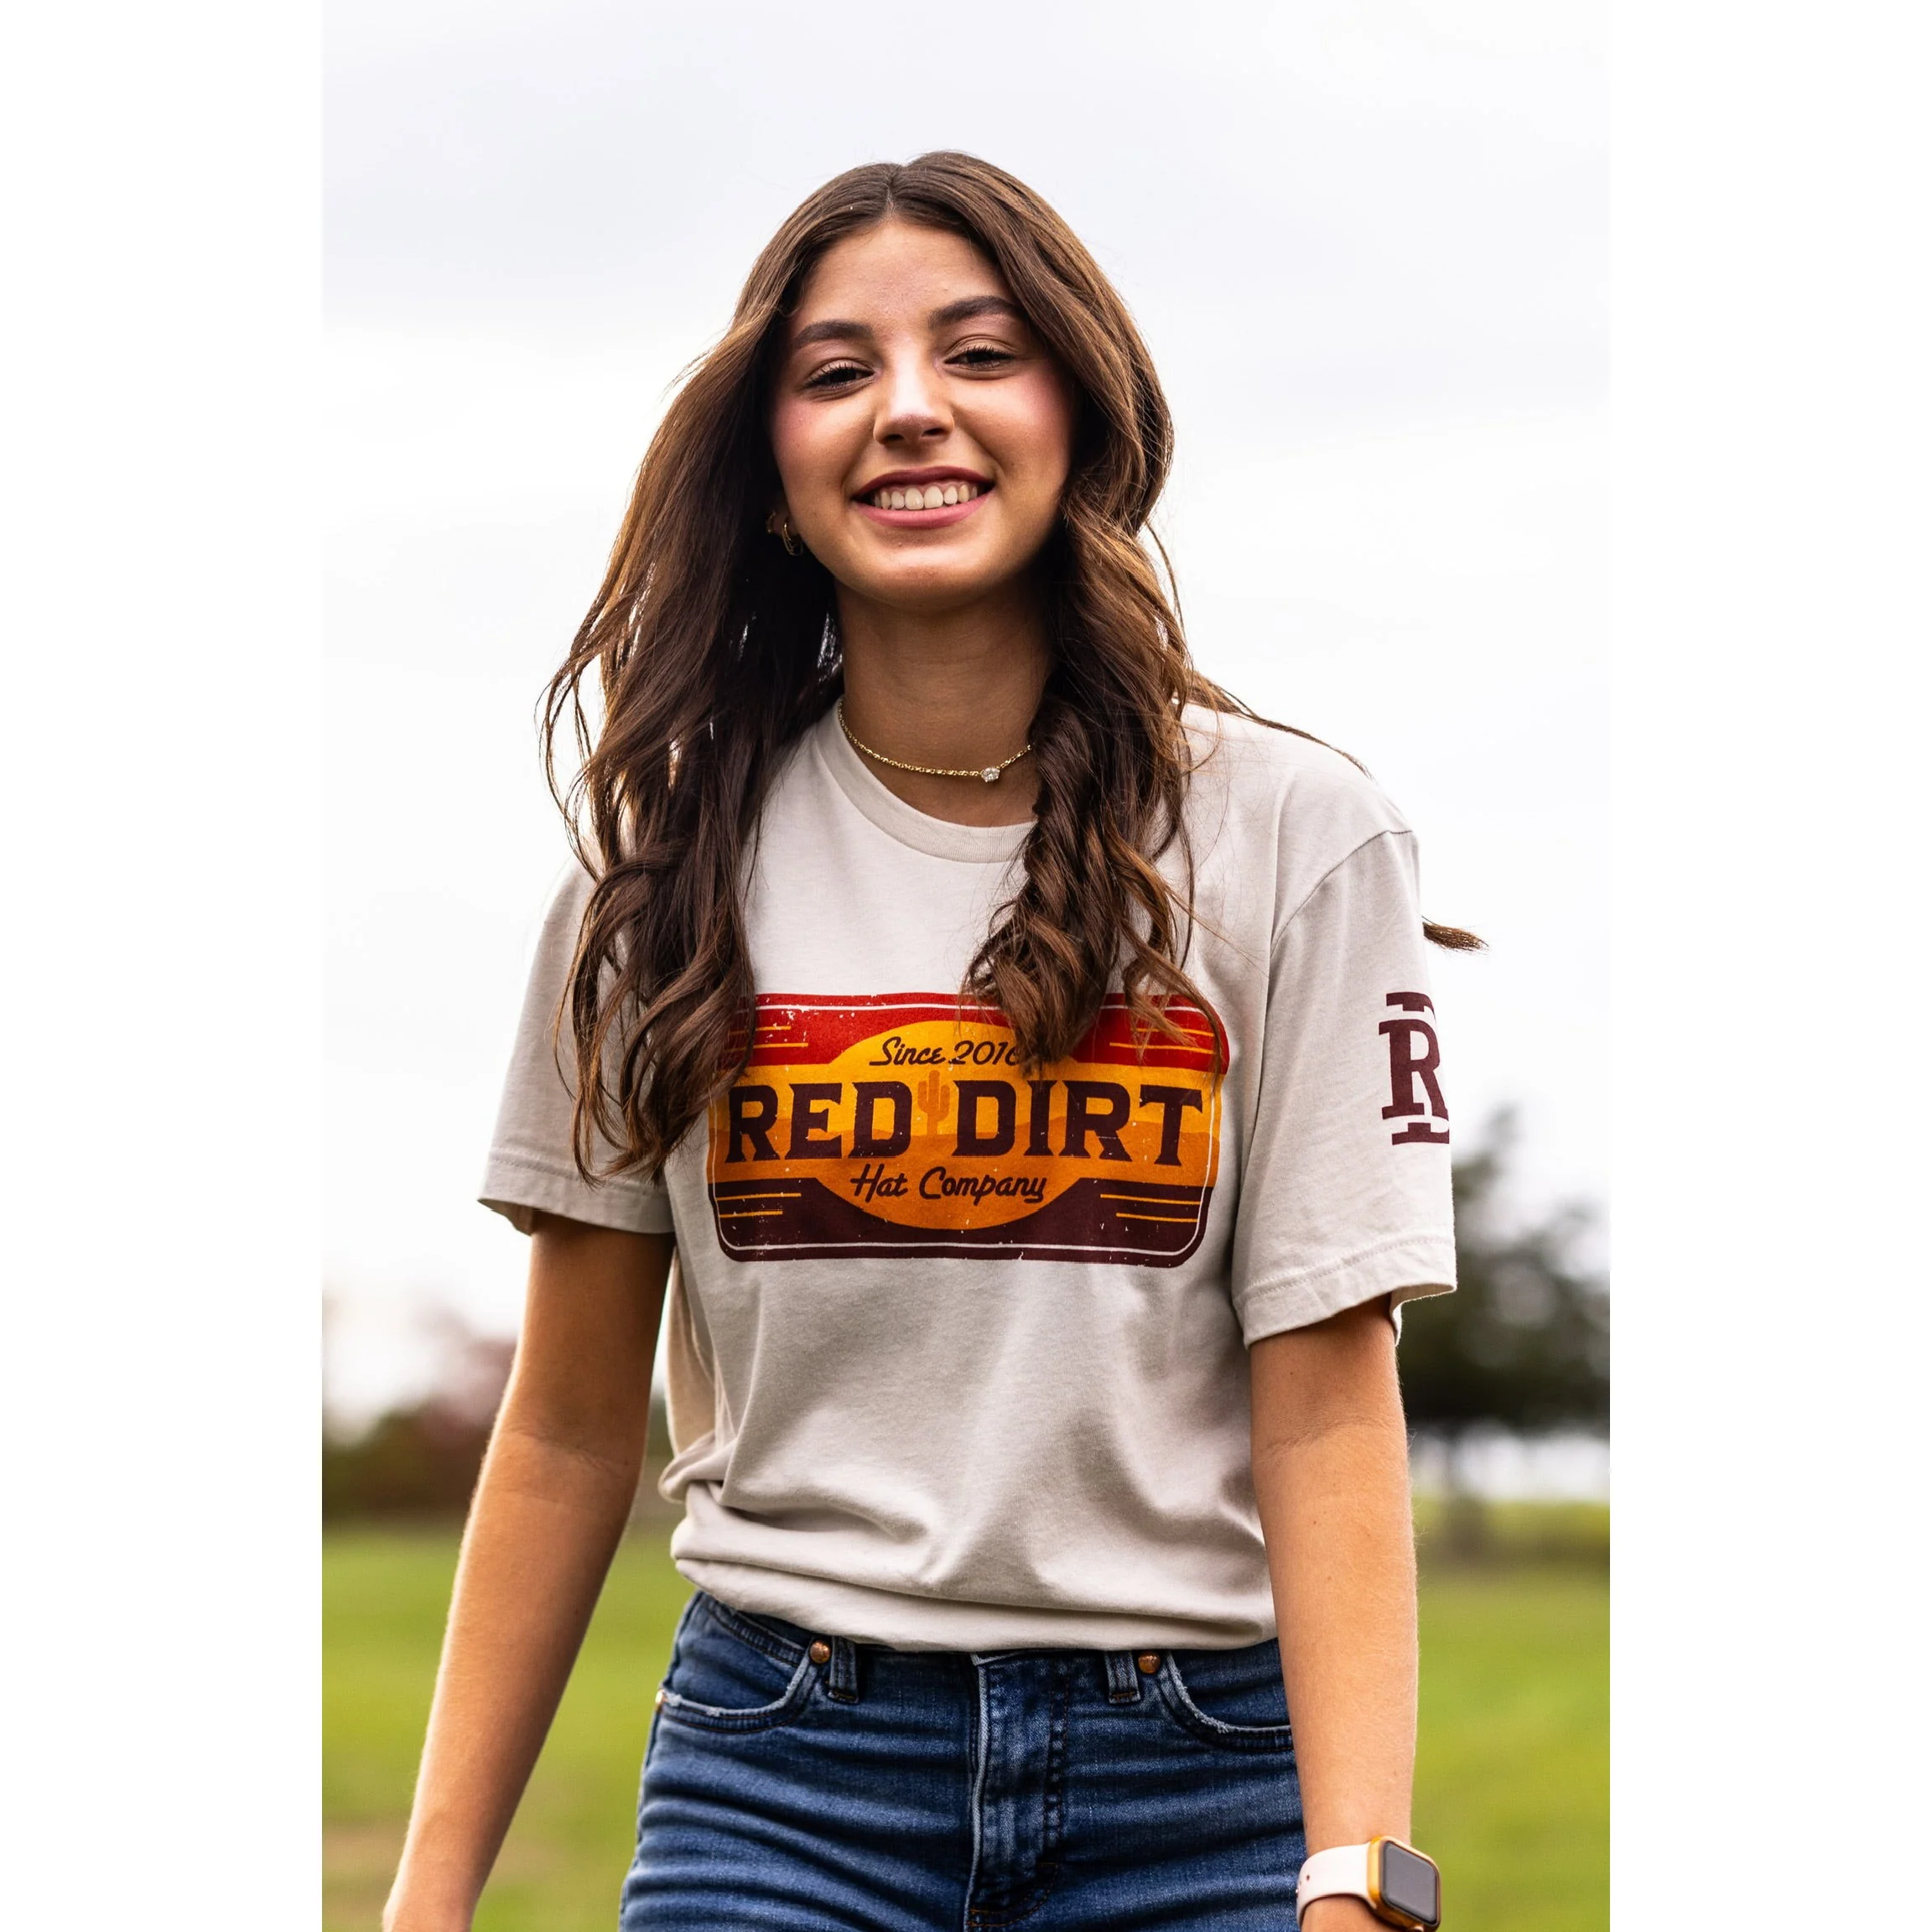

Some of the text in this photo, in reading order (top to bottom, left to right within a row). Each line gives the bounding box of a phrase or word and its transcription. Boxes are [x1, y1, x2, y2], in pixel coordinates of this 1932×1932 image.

[869, 1036, 947, 1066] Since
[725, 1079, 1202, 1166] RED DIRT
[850, 1163, 1047, 1206] Hat Company
